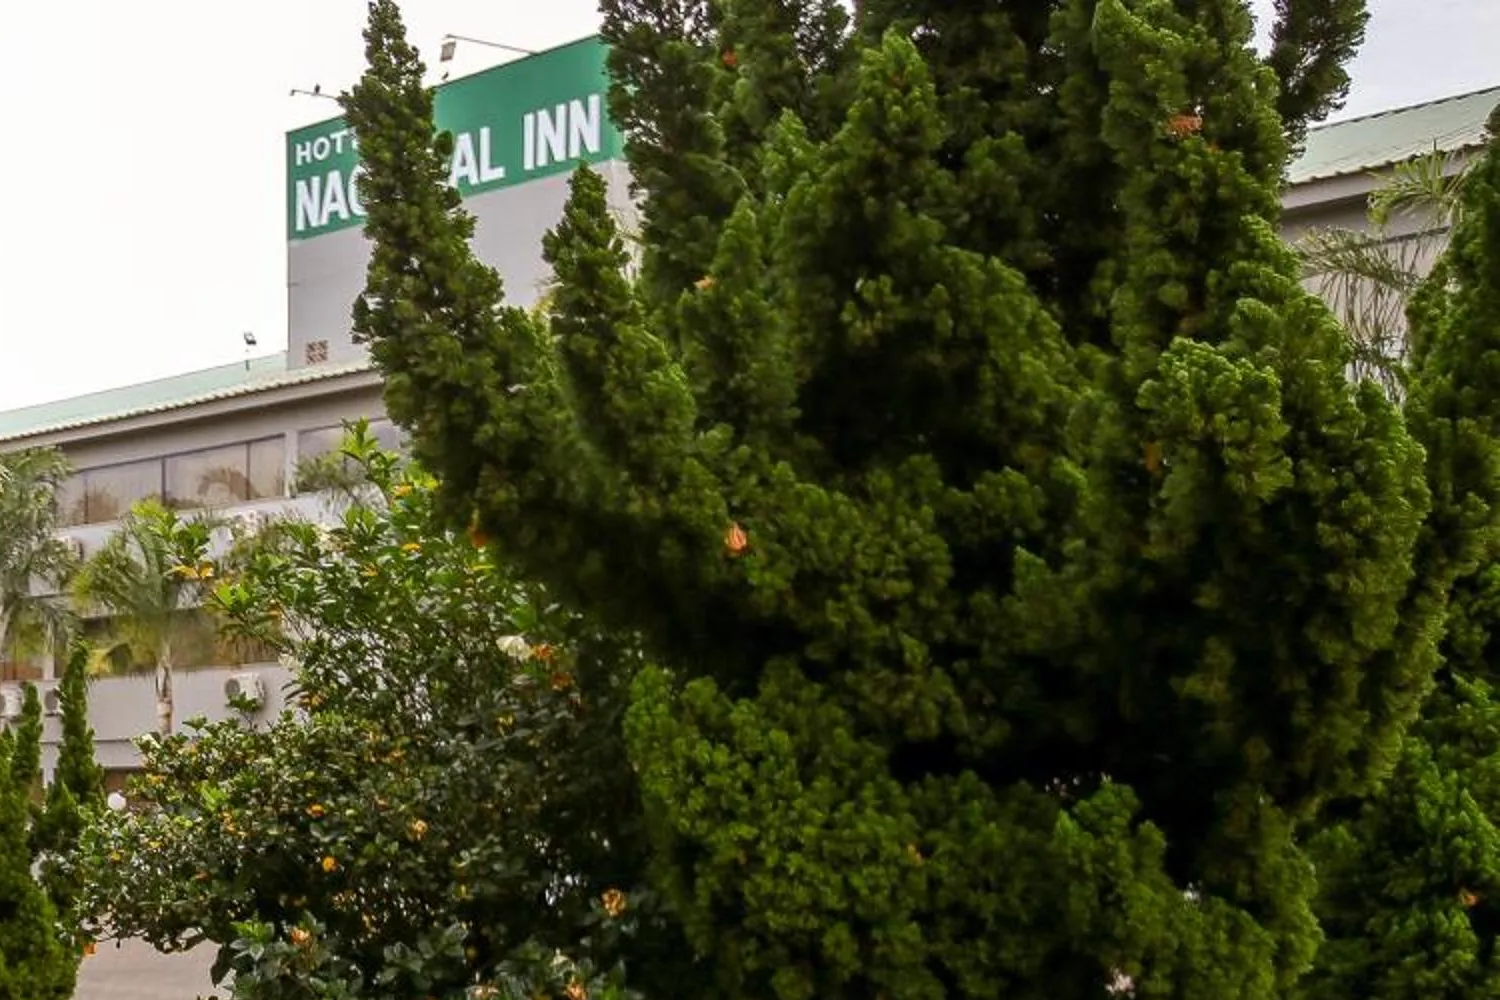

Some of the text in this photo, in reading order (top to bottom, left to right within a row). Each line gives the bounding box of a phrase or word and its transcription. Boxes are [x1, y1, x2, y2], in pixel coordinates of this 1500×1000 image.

[296, 127, 358, 166] HOT
[296, 94, 600, 231] NACAL INN
